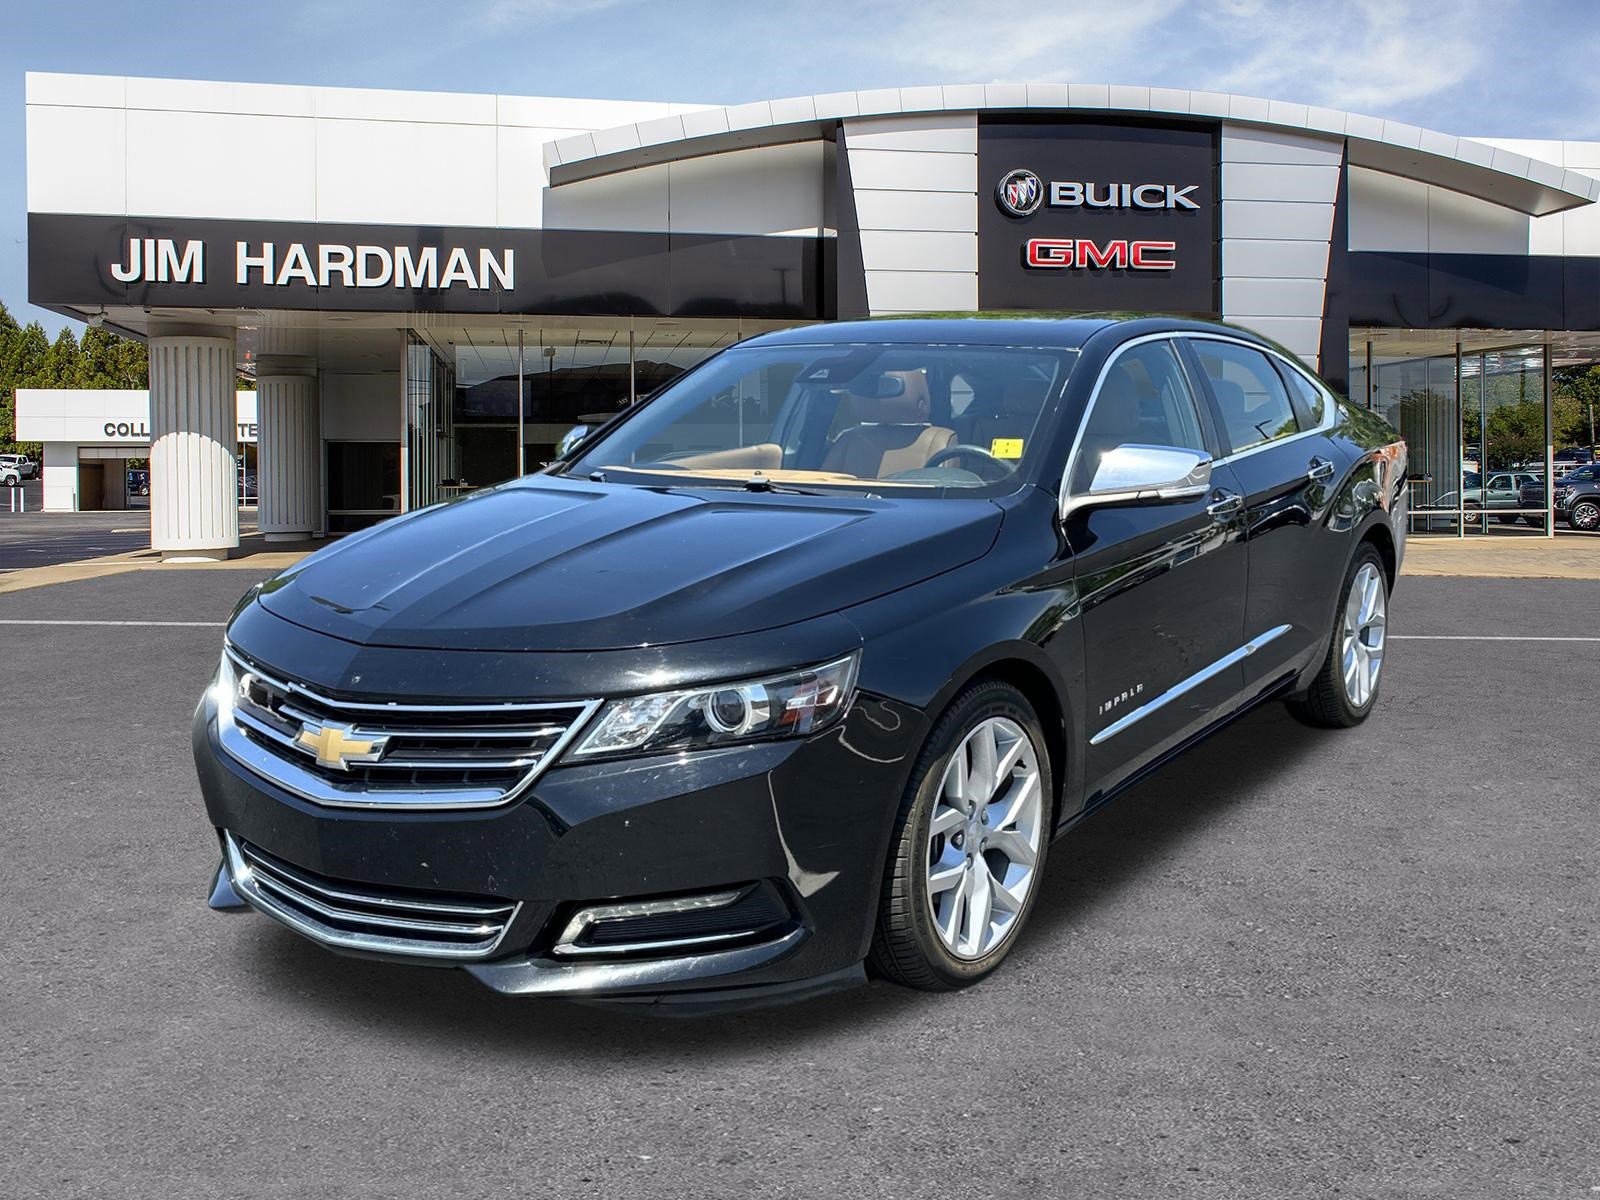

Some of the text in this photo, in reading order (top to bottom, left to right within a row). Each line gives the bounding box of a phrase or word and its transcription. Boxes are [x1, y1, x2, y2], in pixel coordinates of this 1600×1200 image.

[1050, 181, 1200, 209] BUICK
[110, 238, 515, 290] JIM HARDMAN
[1026, 238, 1176, 270] GMC
[104, 422, 258, 437] COLL TE
[1098, 683, 1144, 715] IMPALA
